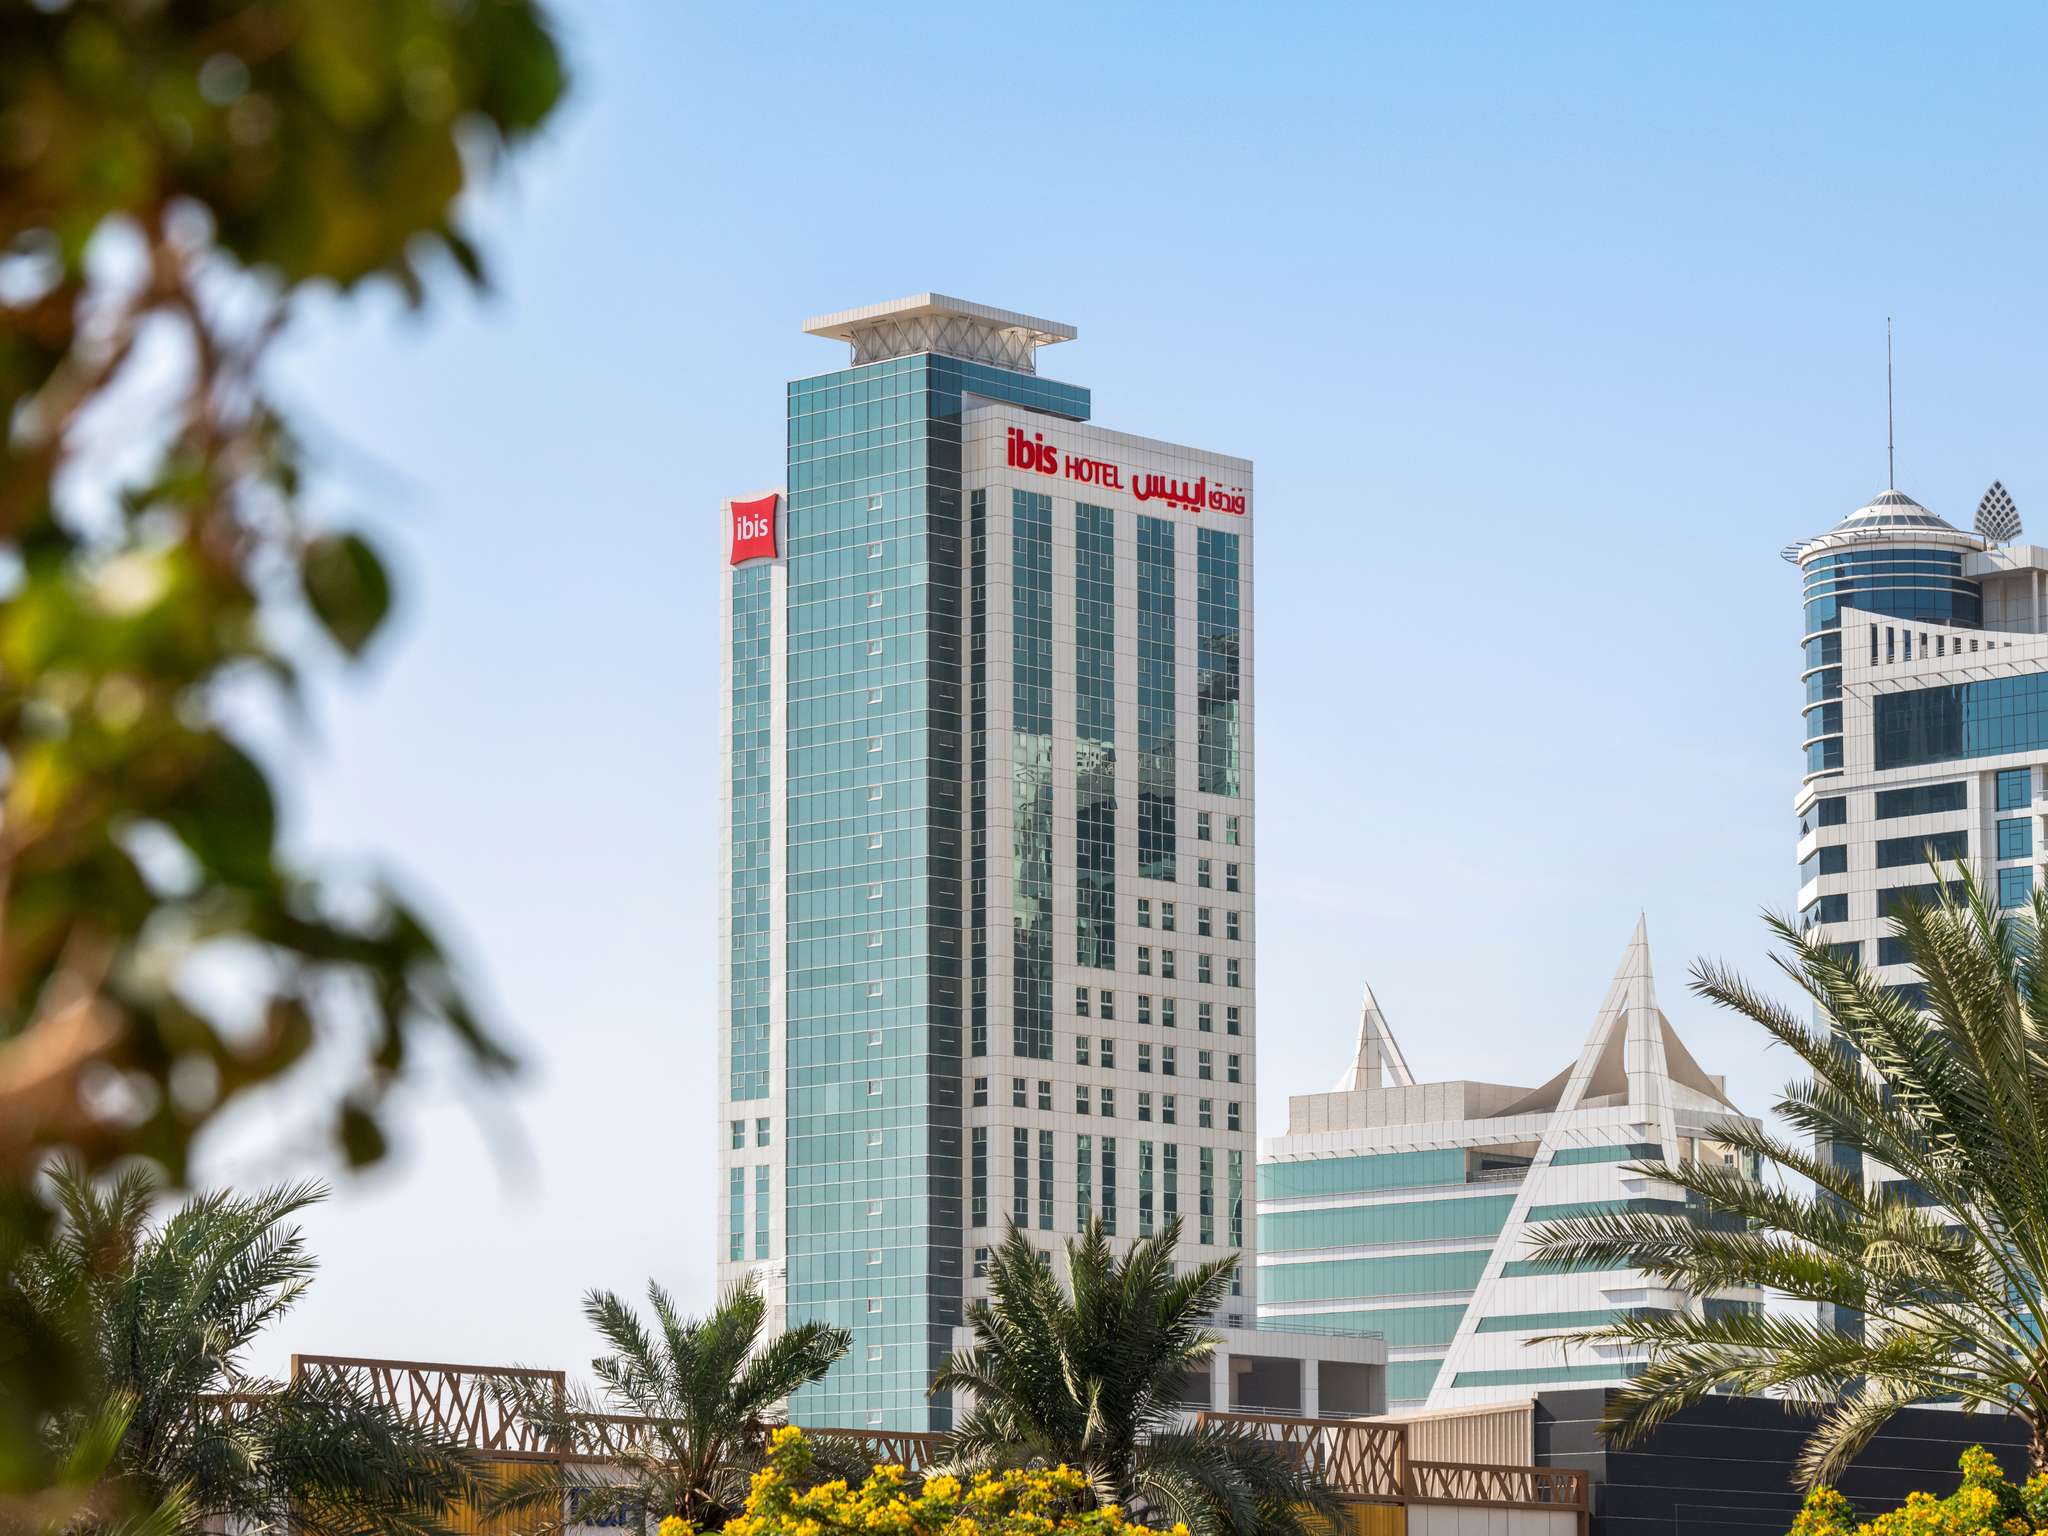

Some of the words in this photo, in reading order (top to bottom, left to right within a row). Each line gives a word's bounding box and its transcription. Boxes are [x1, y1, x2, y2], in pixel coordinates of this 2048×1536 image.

[1007, 427, 1058, 475] ibis
[1065, 455, 1124, 490] HOTEL
[1208, 482, 1246, 515] فندق
[737, 513, 769, 541] ibis
